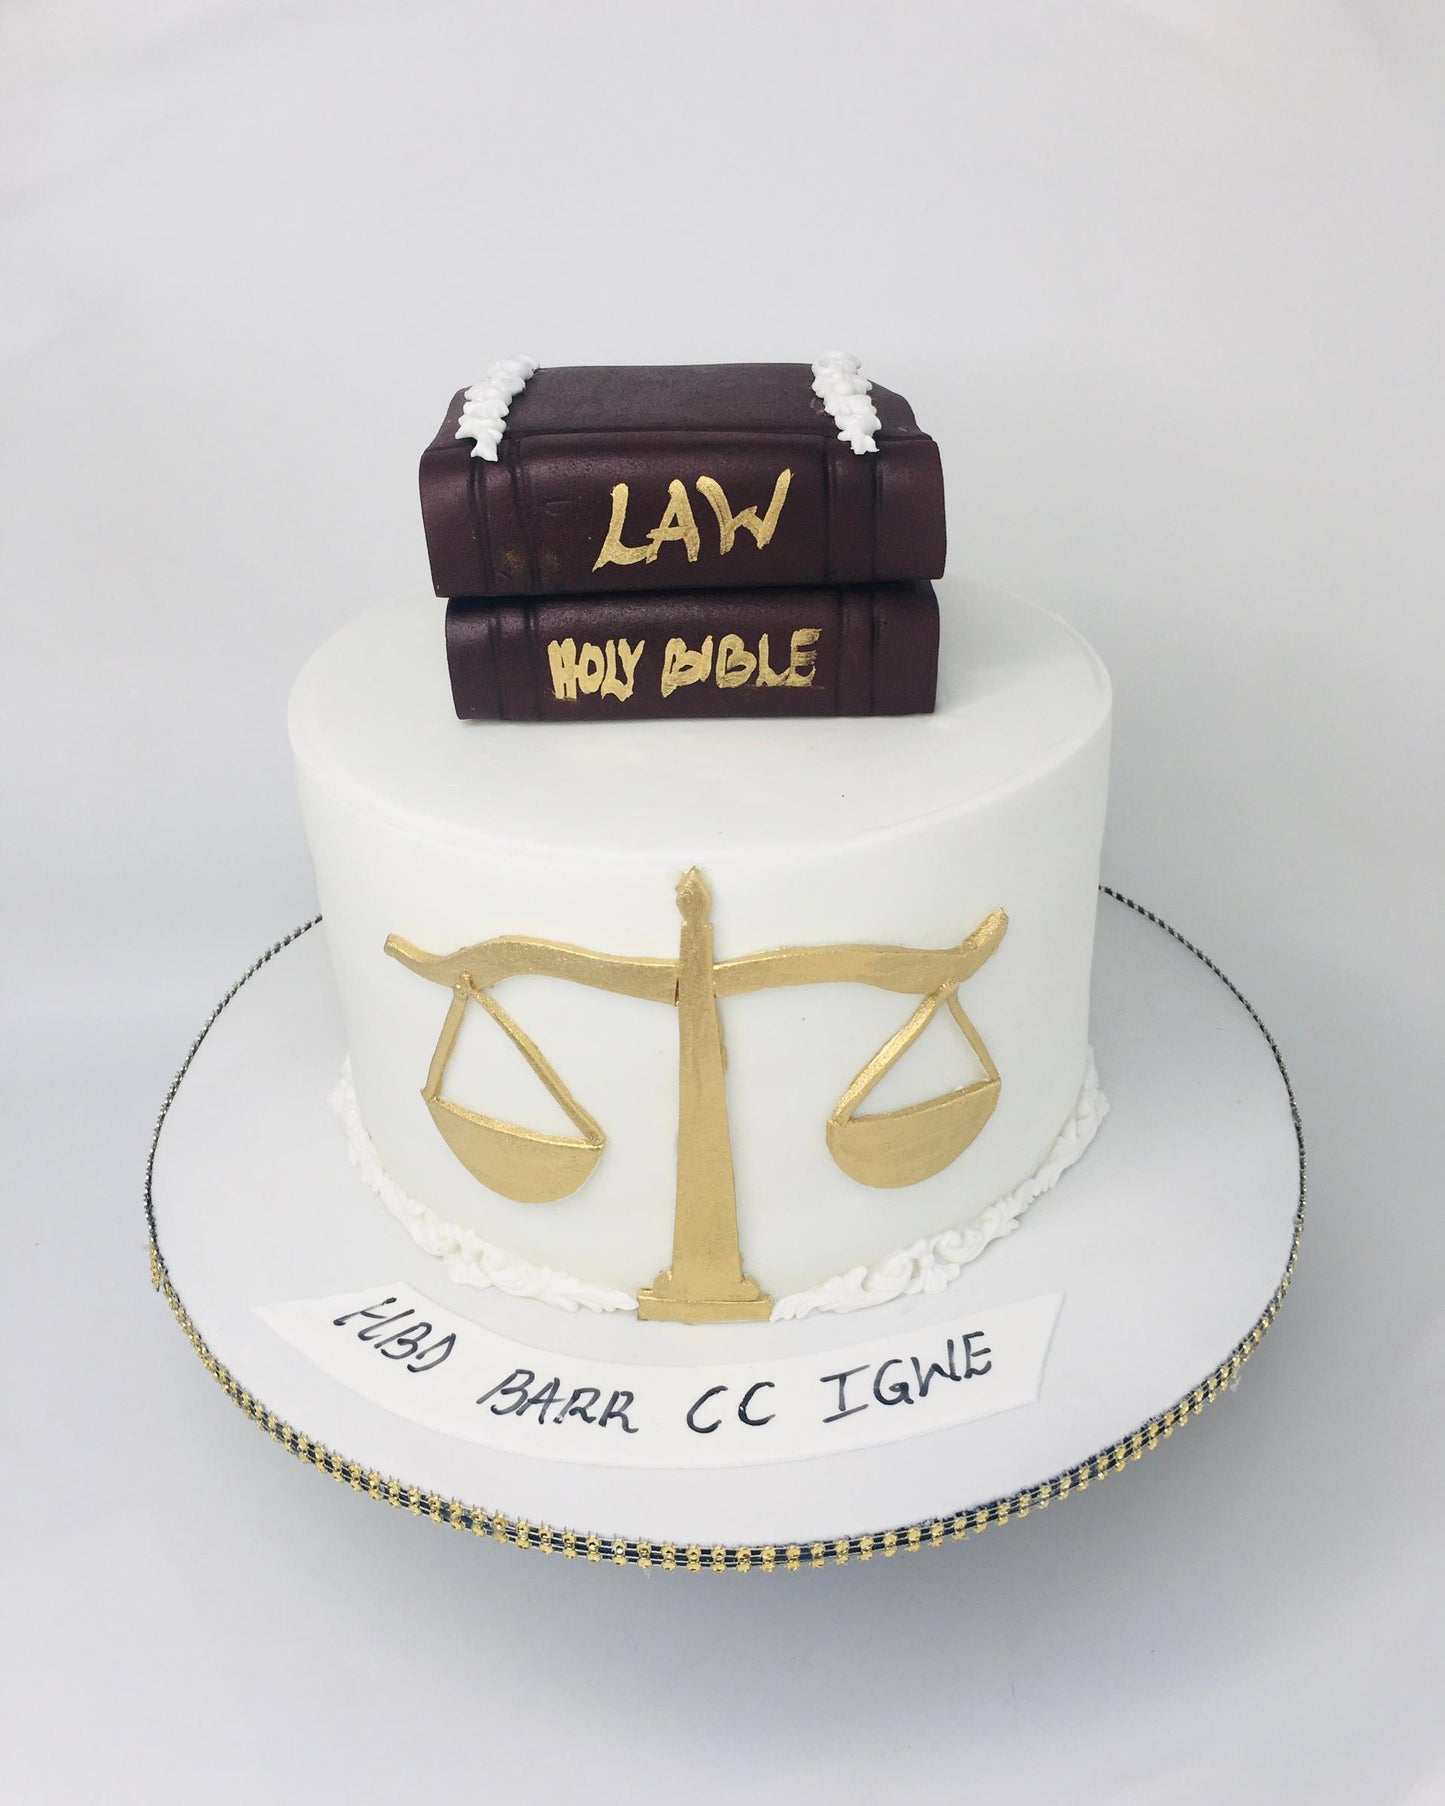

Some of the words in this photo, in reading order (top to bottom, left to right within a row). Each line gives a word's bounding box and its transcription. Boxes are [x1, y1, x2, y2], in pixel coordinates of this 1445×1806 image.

[592, 468, 793, 572] LAW
[547, 637, 646, 702] HOLY
[660, 628, 822, 699] BIBLE
[332, 1297, 458, 1374] HBD
[475, 1368, 640, 1435] BARR
[820, 1331, 993, 1424] IGWE
